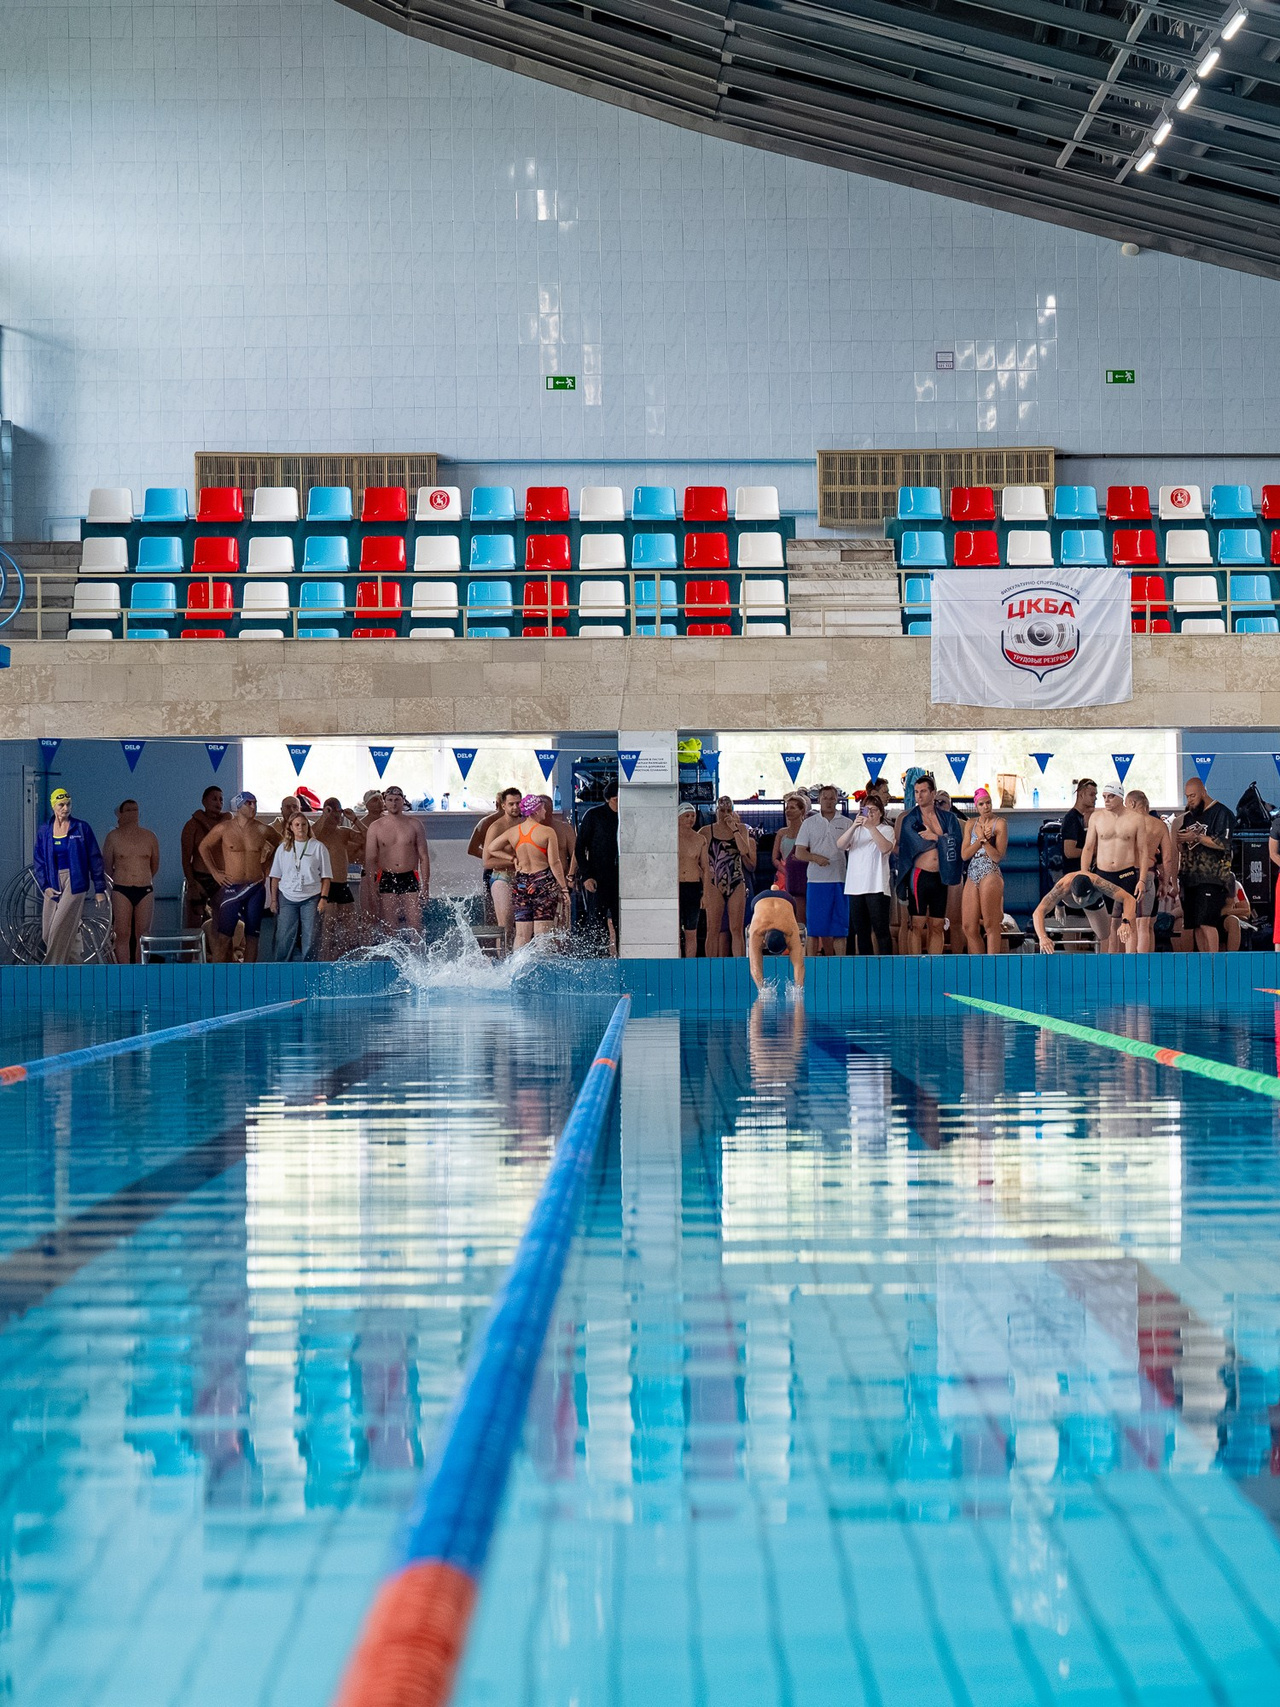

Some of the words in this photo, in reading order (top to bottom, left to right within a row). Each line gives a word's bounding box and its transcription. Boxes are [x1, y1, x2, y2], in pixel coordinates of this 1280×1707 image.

[1007, 598, 1076, 619] ЦКБА
[1013, 654, 1042, 664] ТРУДОВЫЕ
[1043, 653, 1069, 663] РЕЗЕРВЫ
